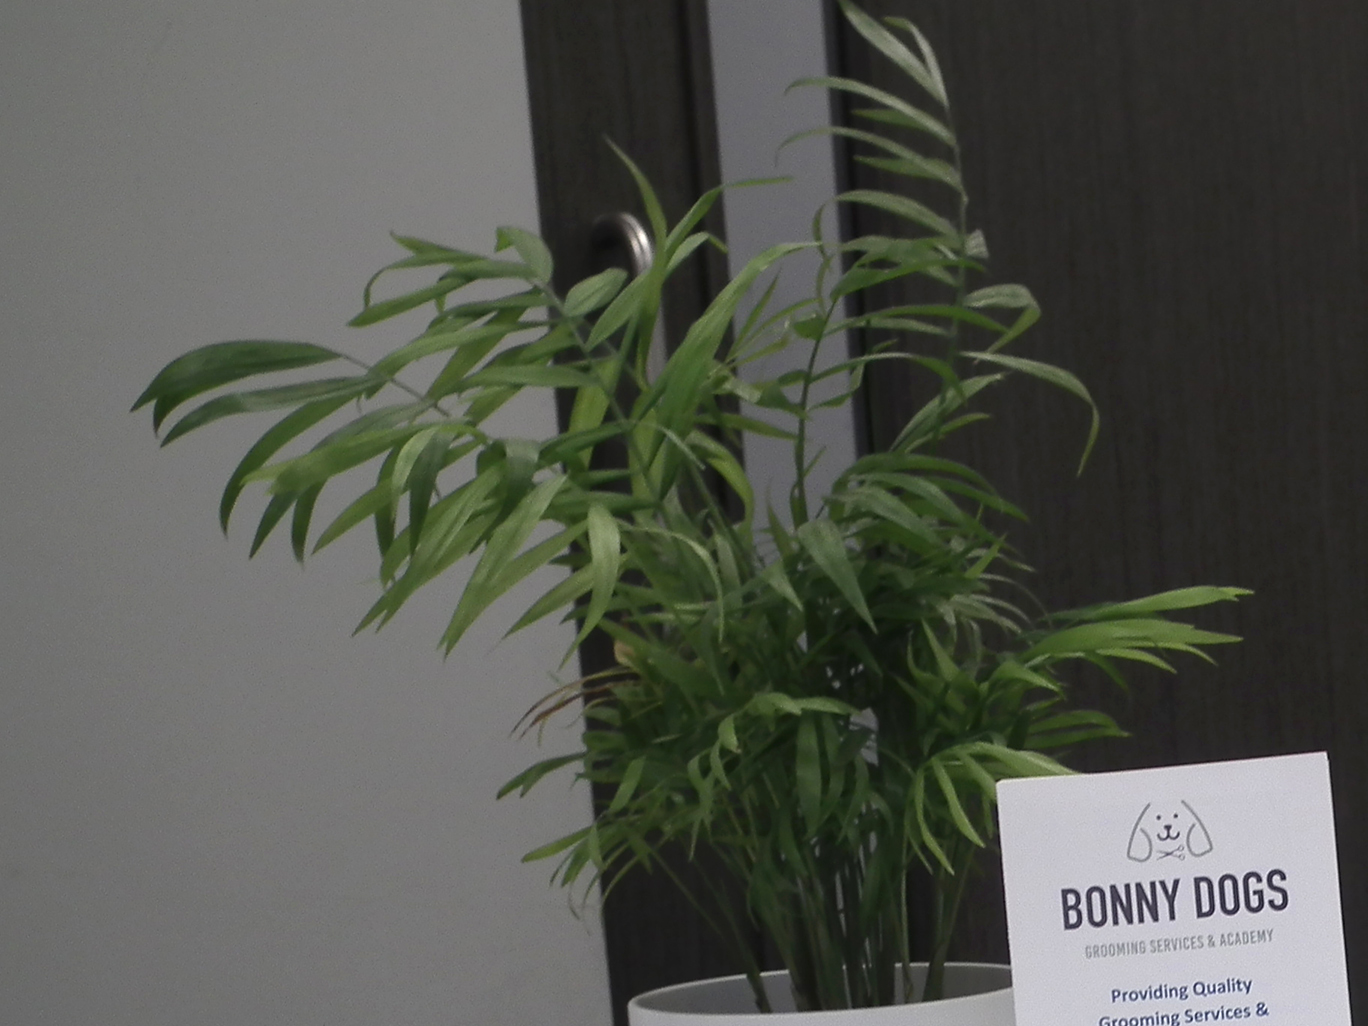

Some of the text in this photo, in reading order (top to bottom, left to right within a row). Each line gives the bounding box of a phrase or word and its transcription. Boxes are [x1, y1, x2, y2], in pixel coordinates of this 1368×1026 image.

[1060, 868, 1289, 931] BONNY DOGS
[1085, 928, 1274, 959] GROOMING SERVICES & ACADEMY
[1111, 977, 1253, 1004] Providing Quality
[1184, 1004, 1252, 1024] Services
[1256, 1001, 1270, 1016] &
